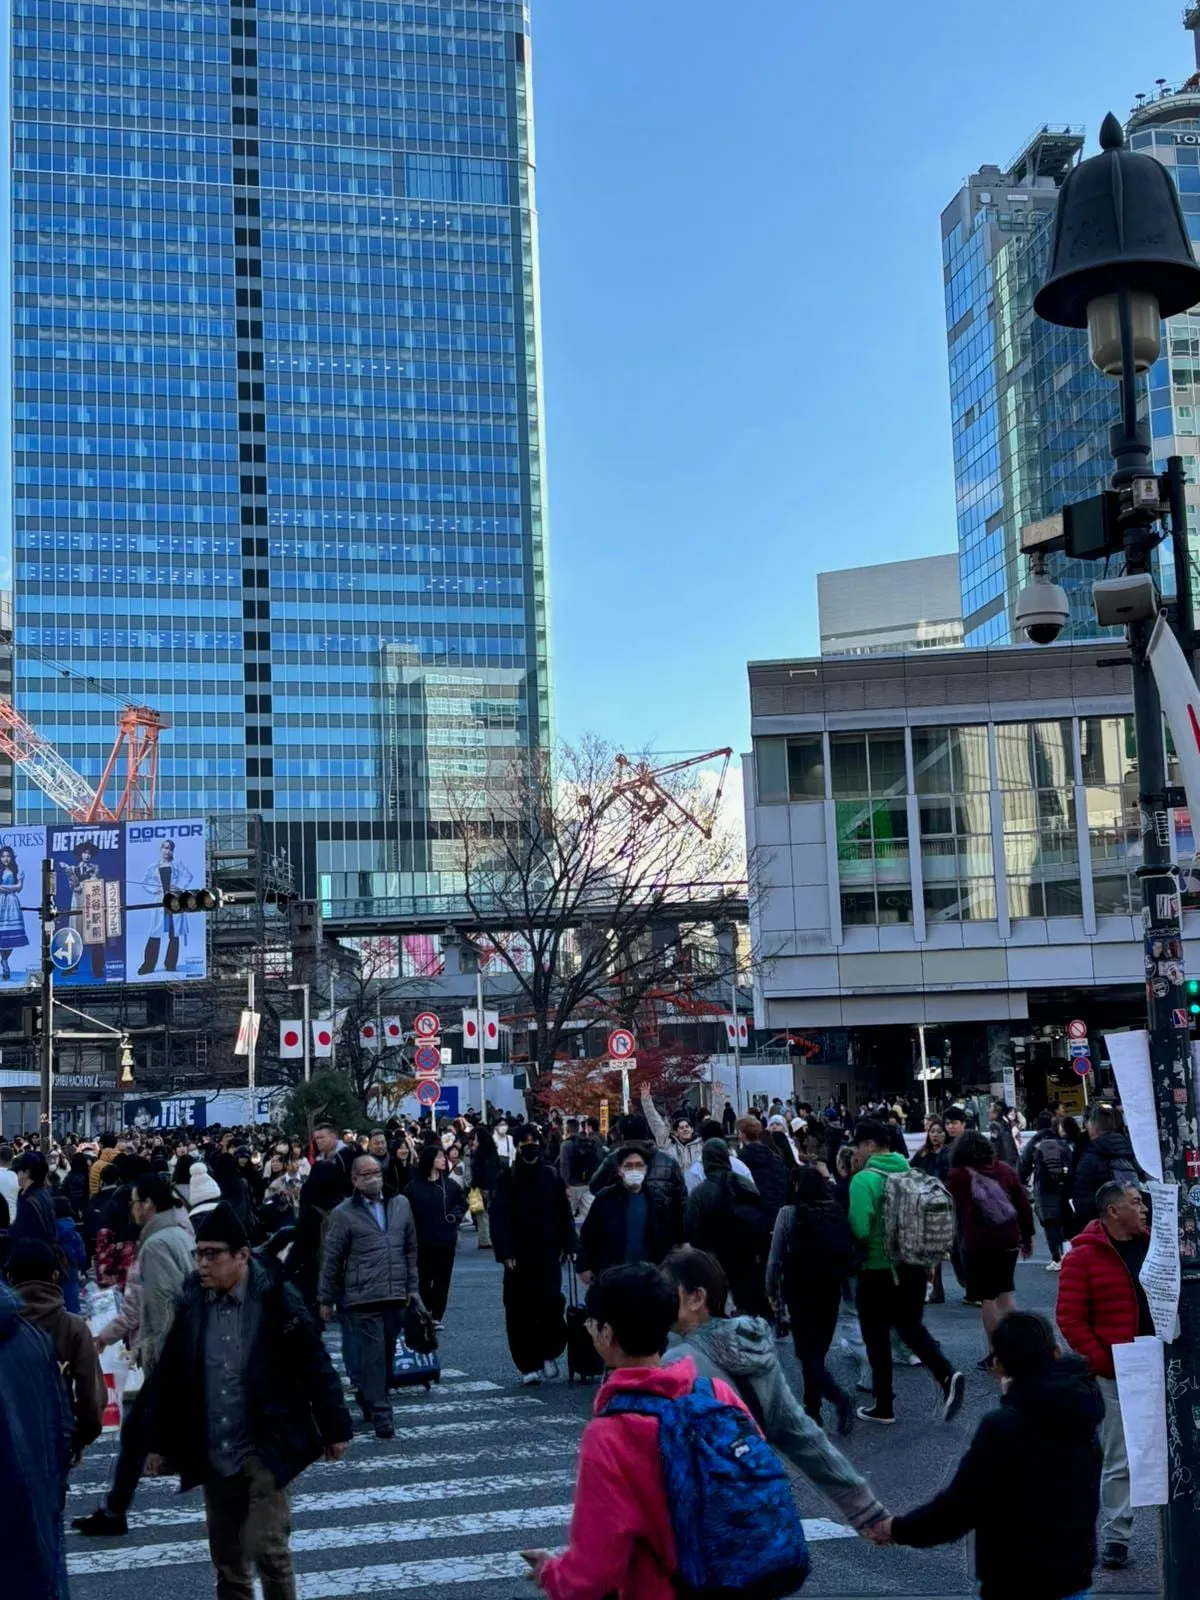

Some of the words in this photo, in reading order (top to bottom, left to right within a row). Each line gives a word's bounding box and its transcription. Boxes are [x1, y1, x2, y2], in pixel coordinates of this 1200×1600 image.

[129, 825, 202, 838] DOCTOR
[92, 886, 101, 937] 渋谷駅前
[611, 1059, 635, 1069] ここまで
